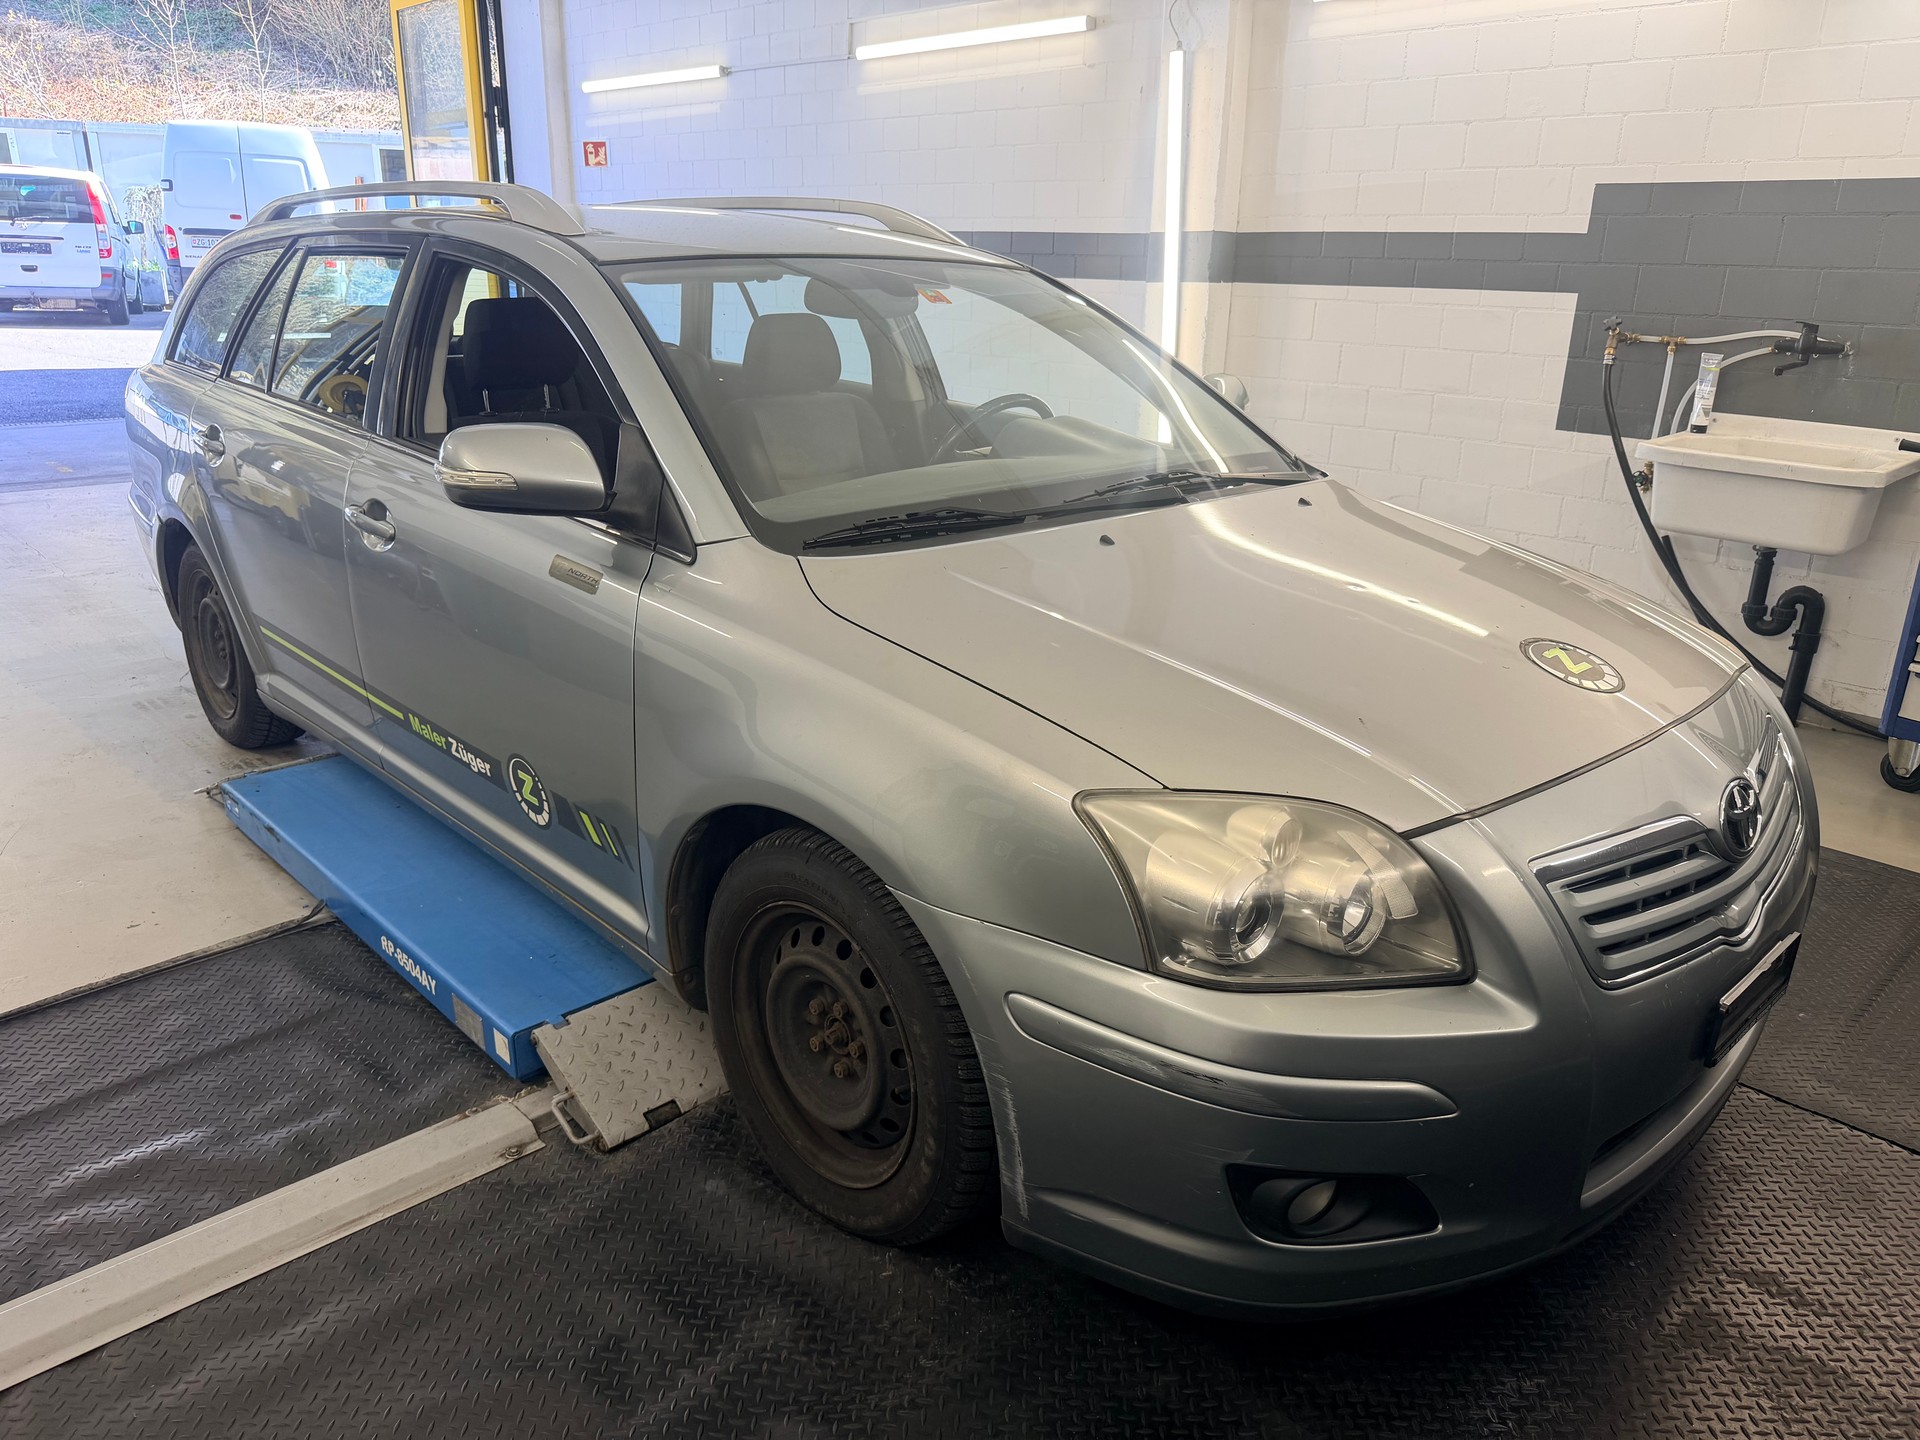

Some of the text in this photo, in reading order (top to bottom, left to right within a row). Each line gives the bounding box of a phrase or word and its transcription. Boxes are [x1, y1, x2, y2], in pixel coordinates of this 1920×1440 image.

[567, 567, 600, 584] NORTH
[408, 713, 493, 777] Maler Züger
[518, 769, 539, 806] Z
[380, 935, 437, 995] RP-8504AY
